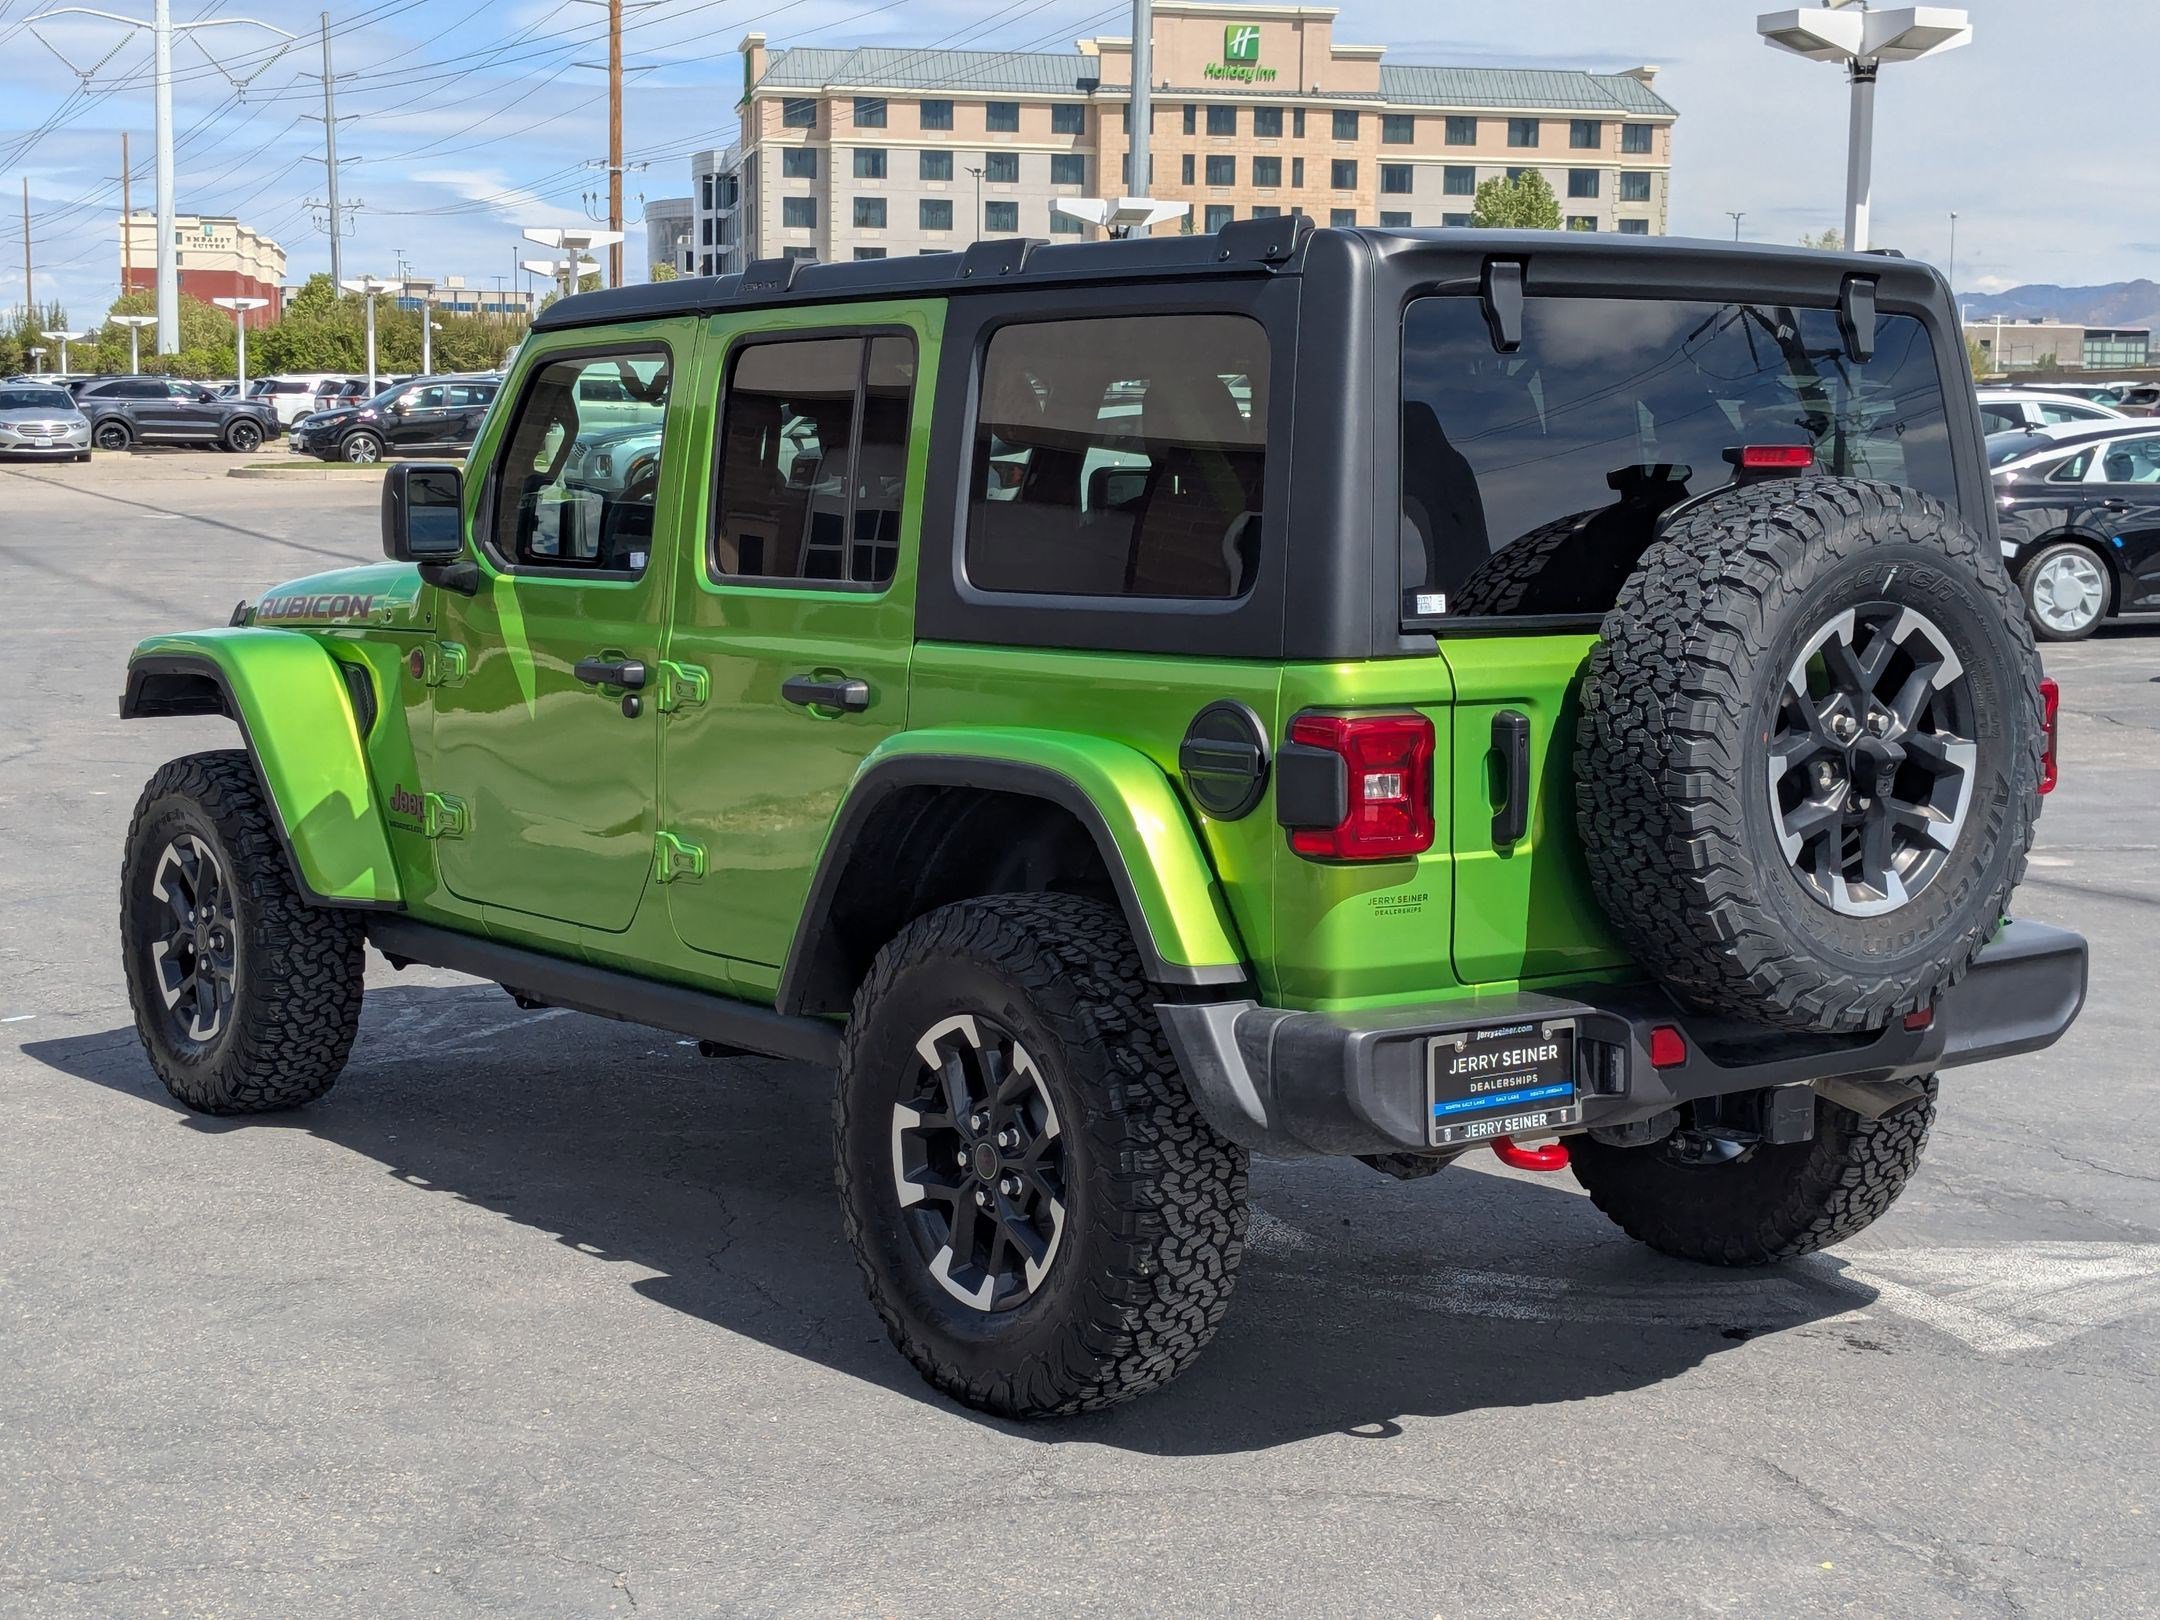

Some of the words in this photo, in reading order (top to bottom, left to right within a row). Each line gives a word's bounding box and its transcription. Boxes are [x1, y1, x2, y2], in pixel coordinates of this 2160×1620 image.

[1204, 63, 1254, 84] Holiday
[1255, 65, 1277, 82] Inn
[257, 595, 373, 619] RUBICON
[390, 784, 424, 823] Jeep
[1368, 896, 1396, 906] JERRY
[1397, 893, 1428, 904] SEINER
[1375, 906, 1421, 916] DEALERSHIPS
[1477, 1025, 1533, 1040] jerryseiner.com
[1449, 1053, 1499, 1075] JERRY
[1502, 1045, 1558, 1066] SEINER
[1470, 1074, 1538, 1092] DEALERSHIPS
[1465, 1120, 1502, 1138] JERRY
[1505, 1113, 1548, 1131] SEINER
